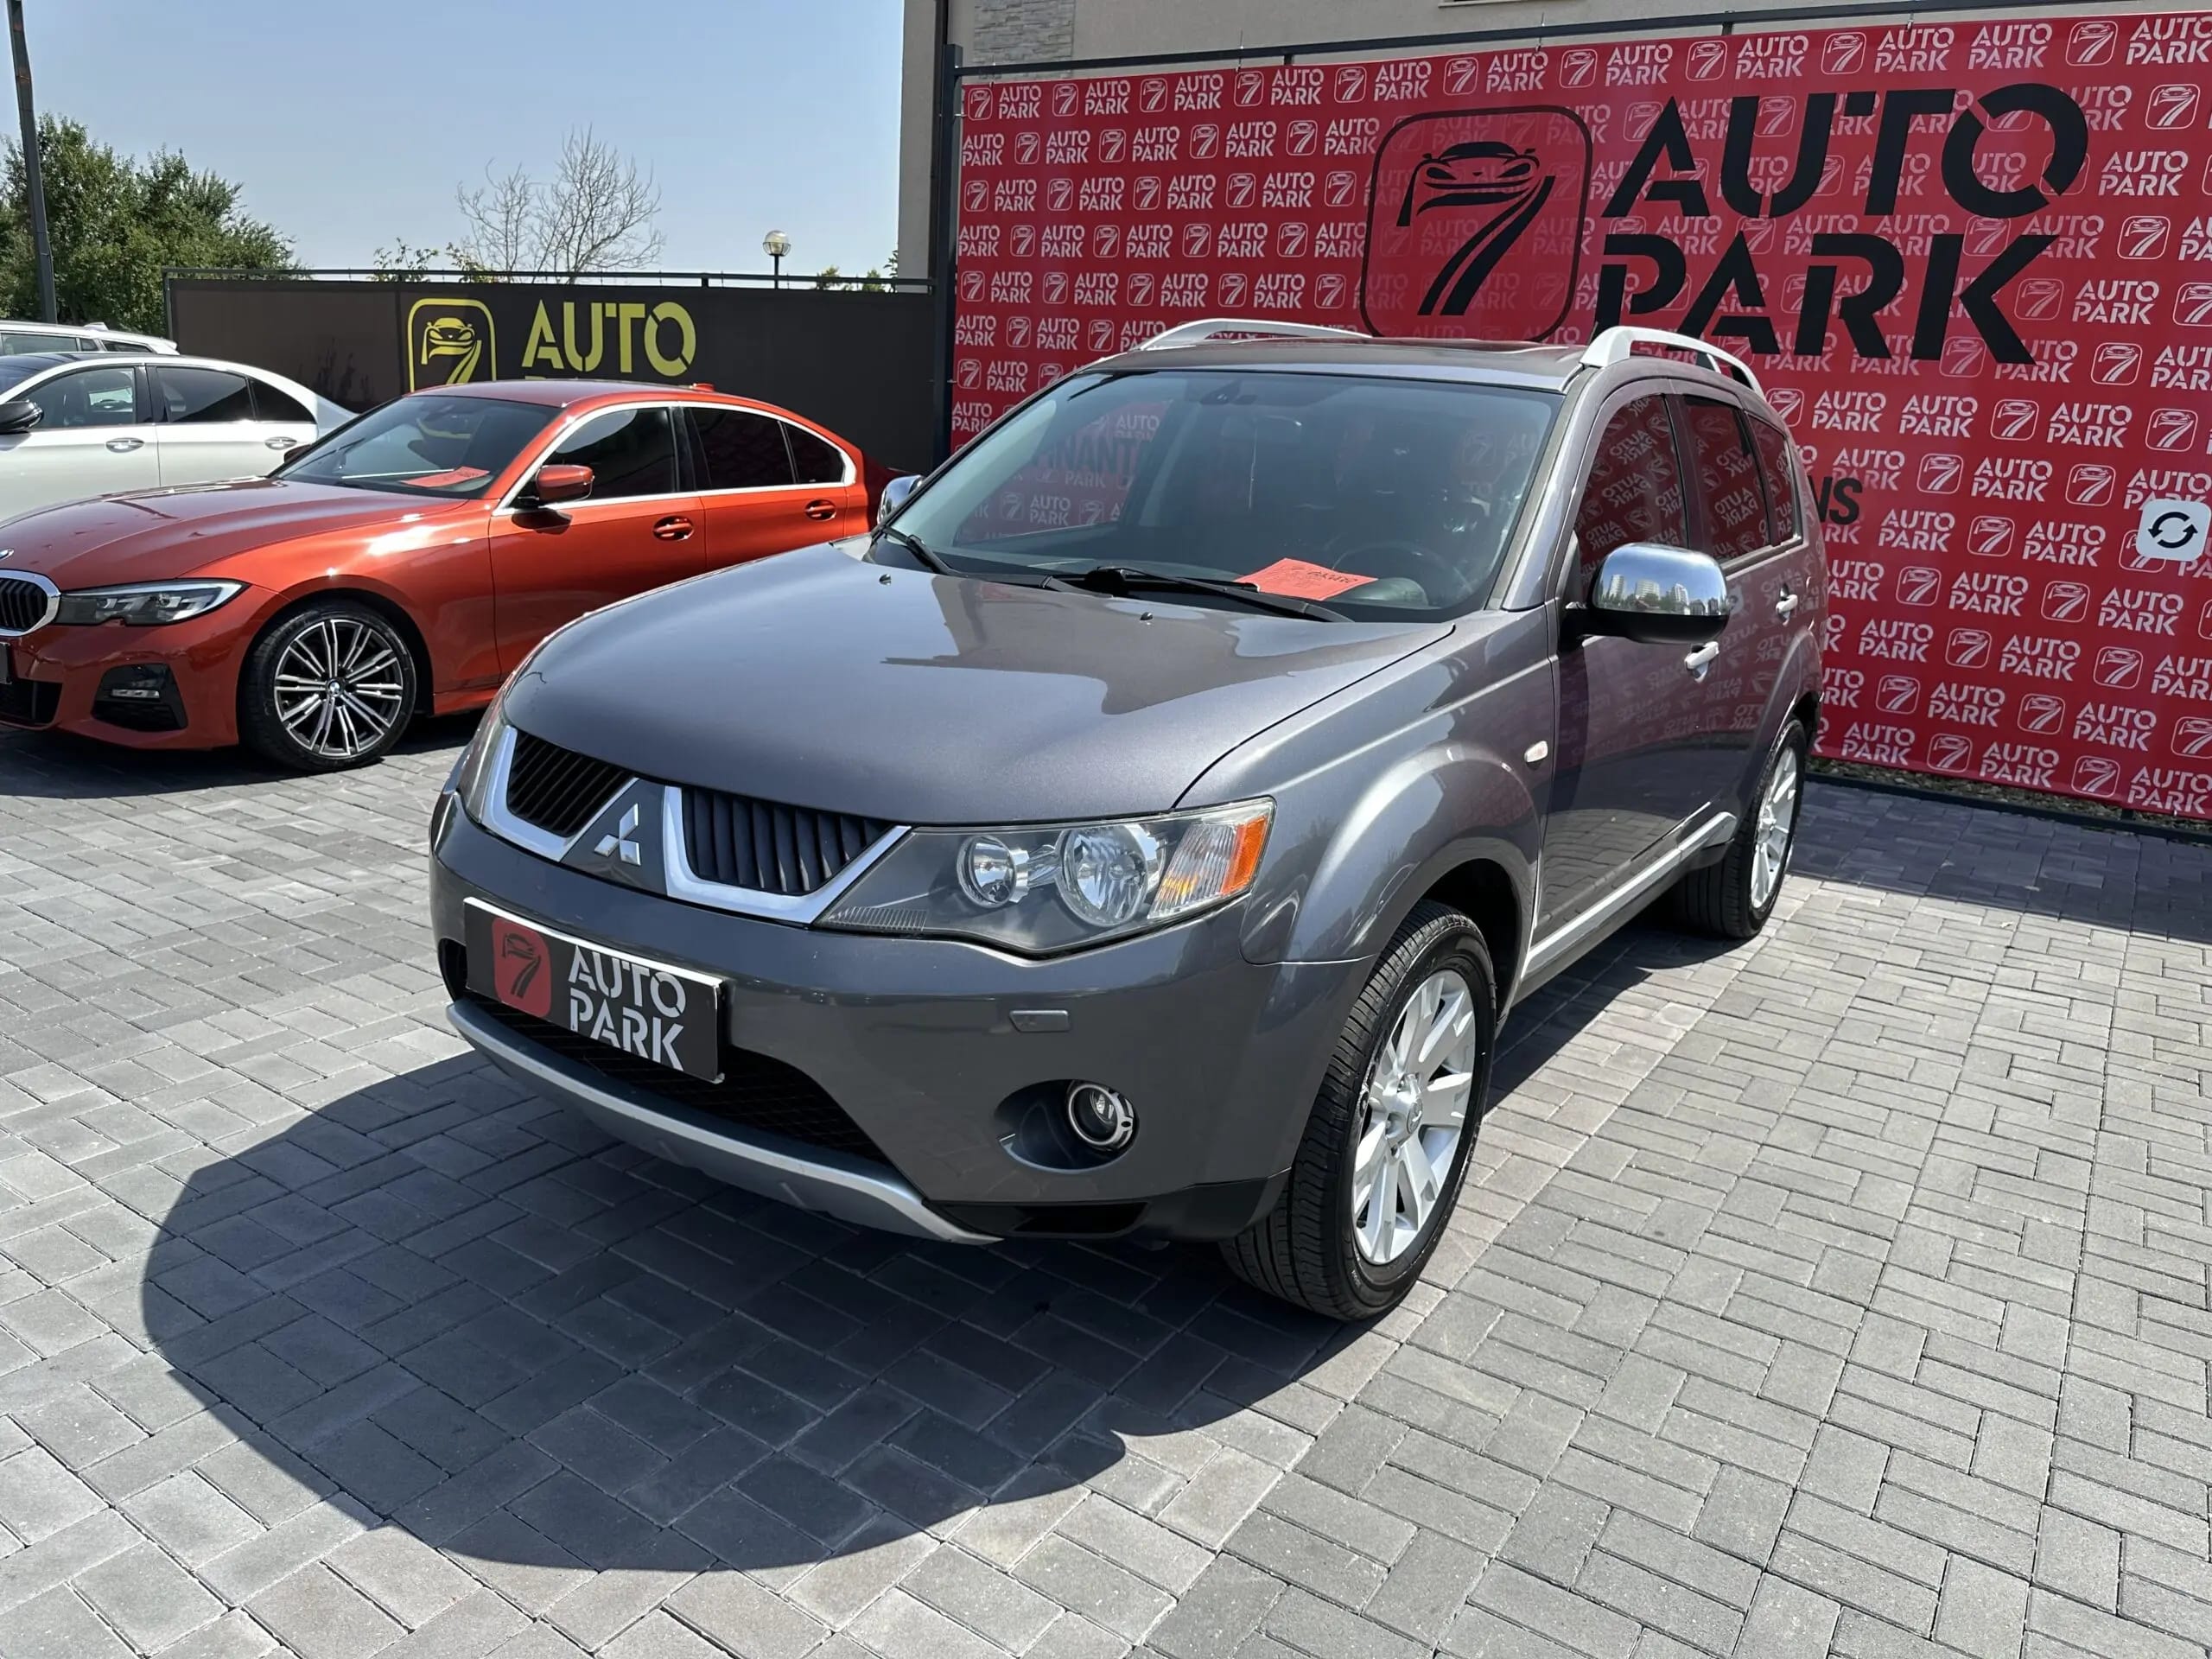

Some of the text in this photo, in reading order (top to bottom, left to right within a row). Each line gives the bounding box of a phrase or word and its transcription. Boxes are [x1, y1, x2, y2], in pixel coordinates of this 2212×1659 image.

[1878, 28, 1955, 51] AUTO
[1972, 23, 2052, 47] AUTO
[1607, 44, 1673, 66] AUTO
[1738, 35, 1808, 57] AUTO
[1488, 51, 1548, 73] AUTO
[1735, 57, 1802, 79] PARK
[1874, 49, 1948, 73] PARK
[1968, 47, 2047, 69] PARK
[1272, 68, 1324, 89] AUTO
[1376, 61, 1432, 84] AUTO
[1486, 72, 1543, 93] PARK
[1605, 65, 1669, 86] PARK
[1085, 80, 1130, 99] AUTO
[1174, 74, 1224, 94] AUTO
[1374, 81, 1428, 101] PARK
[999, 85, 1041, 104] AUTO
[1174, 92, 1221, 111] PARK
[1270, 87, 1321, 106] PARK
[999, 102, 1039, 119] PARK
[1084, 98, 1128, 116] PARK
[1133, 126, 1179, 144] AUTO
[1226, 121, 1276, 142] AUTO
[1325, 118, 1379, 138] AUTO
[963, 132, 1005, 149] AUTO
[1047, 130, 1090, 148] AUTO
[1225, 139, 1274, 157] PARK
[1324, 137, 1377, 156] PARK
[963, 149, 1003, 166] PARK
[1046, 147, 1089, 163] PARK
[1132, 144, 1177, 162] PARK
[1601, 83, 2088, 219] AUTO
[2102, 151, 2189, 173] AUTO
[995, 180, 1037, 196] AUTO
[1080, 177, 1124, 195] AUTO
[1168, 175, 1216, 193] AUTO
[1263, 172, 1315, 193] AUTO
[2098, 174, 2180, 196] PARK
[995, 194, 1035, 212] PARK
[1079, 193, 1122, 211] PARK
[1166, 190, 1213, 208] PARK
[1262, 188, 1312, 207] PARK
[959, 226, 1000, 242] AUTO
[1042, 225, 1084, 242] AUTO
[1127, 225, 1173, 243] AUTO
[1218, 223, 1268, 242] AUTO
[1316, 222, 1367, 240] AUTO
[1656, 216, 1722, 234] AUTO
[1786, 215, 1858, 234] AUTO
[1874, 215, 1950, 234] AUTO
[2022, 215, 2105, 237] AUTO
[958, 240, 998, 257] PARK
[1041, 240, 1083, 257] PARK
[1126, 240, 1171, 258] PARK
[1217, 239, 1264, 258] PARK
[1314, 239, 1363, 258] PARK
[992, 272, 1033, 289] AUTO
[1076, 273, 1119, 289] AUTO
[1162, 274, 1208, 290] AUTO
[1255, 274, 1305, 291] AUTO
[990, 287, 1031, 303] PARK
[1074, 289, 1116, 305] PARK
[1160, 289, 1205, 307] PARK
[1254, 291, 1302, 309] PARK
[1588, 234, 2060, 365] PARK
[2075, 280, 2158, 302] AUTO
[957, 315, 996, 332] AUTO
[2073, 302, 2155, 325] PARK
[1038, 319, 1079, 335] AUTO
[522, 299, 696, 377] AUTO
[956, 331, 995, 346] PARK
[1037, 334, 1077, 349] PARK
[988, 360, 1028, 377] AUTO
[1764, 353, 1834, 372] PARK
[987, 376, 1026, 392] PARK
[953, 402, 992, 418] AUTO
[1814, 391, 1886, 412] AUTO
[1902, 394, 1978, 416] AUTO
[1812, 411, 1881, 432] PARK
[2049, 402, 2133, 425] AUTO
[1900, 416, 1973, 437] PARK
[2047, 424, 2127, 448] PARK
[1834, 448, 1904, 468] AUTO
[1974, 458, 2053, 479] AUTO
[1972, 479, 2045, 502] PARK
[2127, 468, 2212, 493] AUTO
[1880, 510, 1955, 531] AUTO
[1878, 530, 1951, 552] PARK
[2025, 521, 2106, 544] AUTO
[2023, 543, 2101, 566] PARK
[1953, 571, 2029, 594] AUTO
[1948, 594, 2024, 616] PARK
[2101, 588, 2183, 612] AUTO
[1862, 619, 1933, 643] AUTO
[2098, 611, 2178, 636] PARK
[1859, 640, 1929, 663] PARK
[2003, 635, 2081, 659] AUTO
[1999, 658, 2075, 681] PARK
[1931, 683, 2005, 706] AUTO
[1928, 705, 1999, 728] PARK
[2076, 702, 2156, 728] AUTO
[1845, 723, 1915, 746] AUTO
[2074, 726, 2152, 751] PARK
[1841, 743, 1910, 765] PARK
[1983, 741, 2059, 767] AUTO
[1980, 763, 2053, 788] PARK
[2127, 790, 2208, 814] PARK
[569, 945, 686, 1019] AUTO
[569, 988, 685, 1071] PARK
